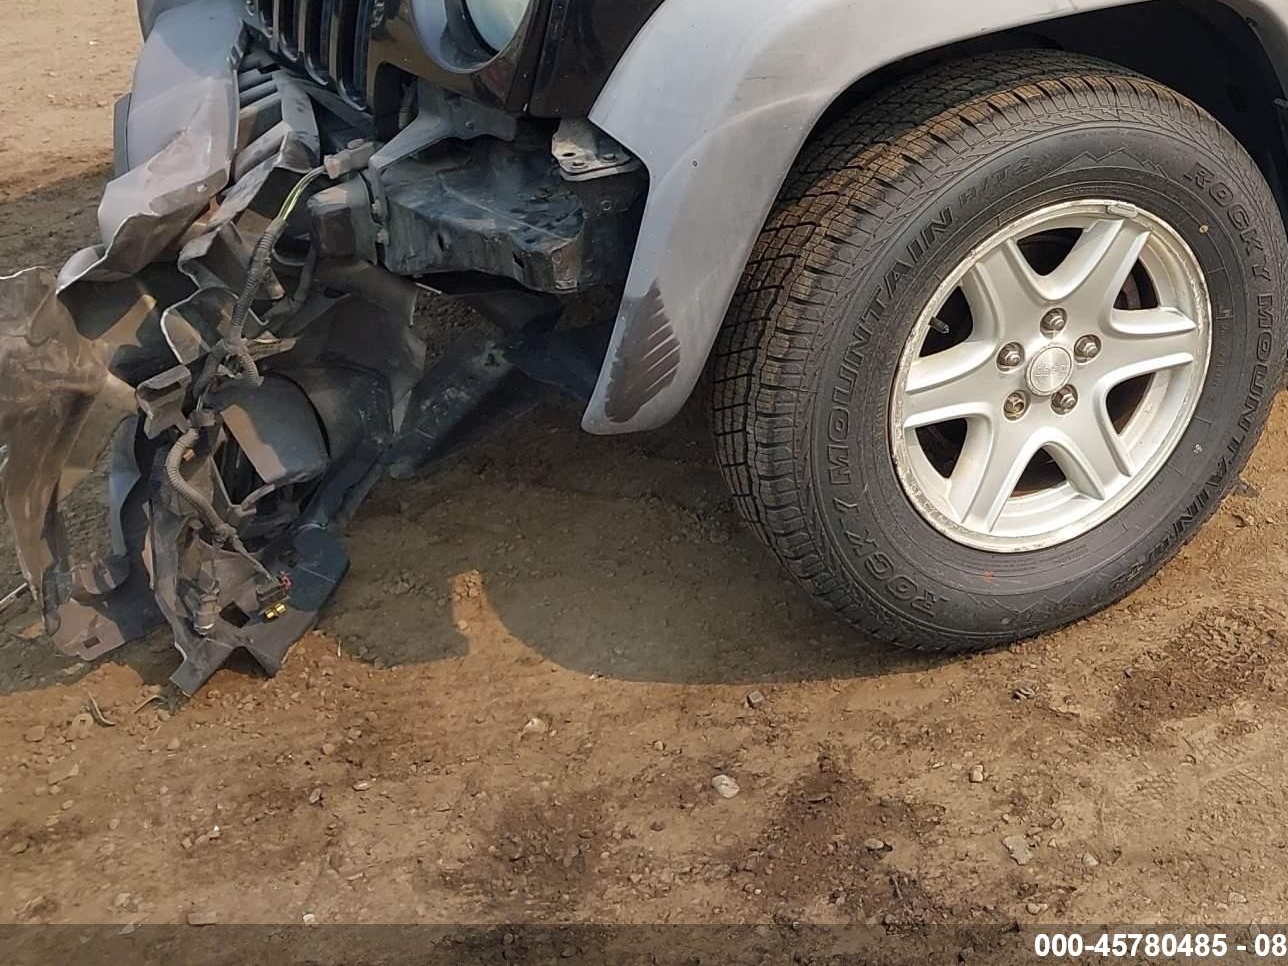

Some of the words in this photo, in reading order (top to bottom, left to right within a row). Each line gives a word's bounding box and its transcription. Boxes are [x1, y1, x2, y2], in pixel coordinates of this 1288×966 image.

[1183, 161, 1272, 282] ROCKY
[827, 206, 955, 485] MOUNTAIN
[1171, 292, 1274, 537] MOUNTAIN
[832, 496, 950, 618] ROCKY
